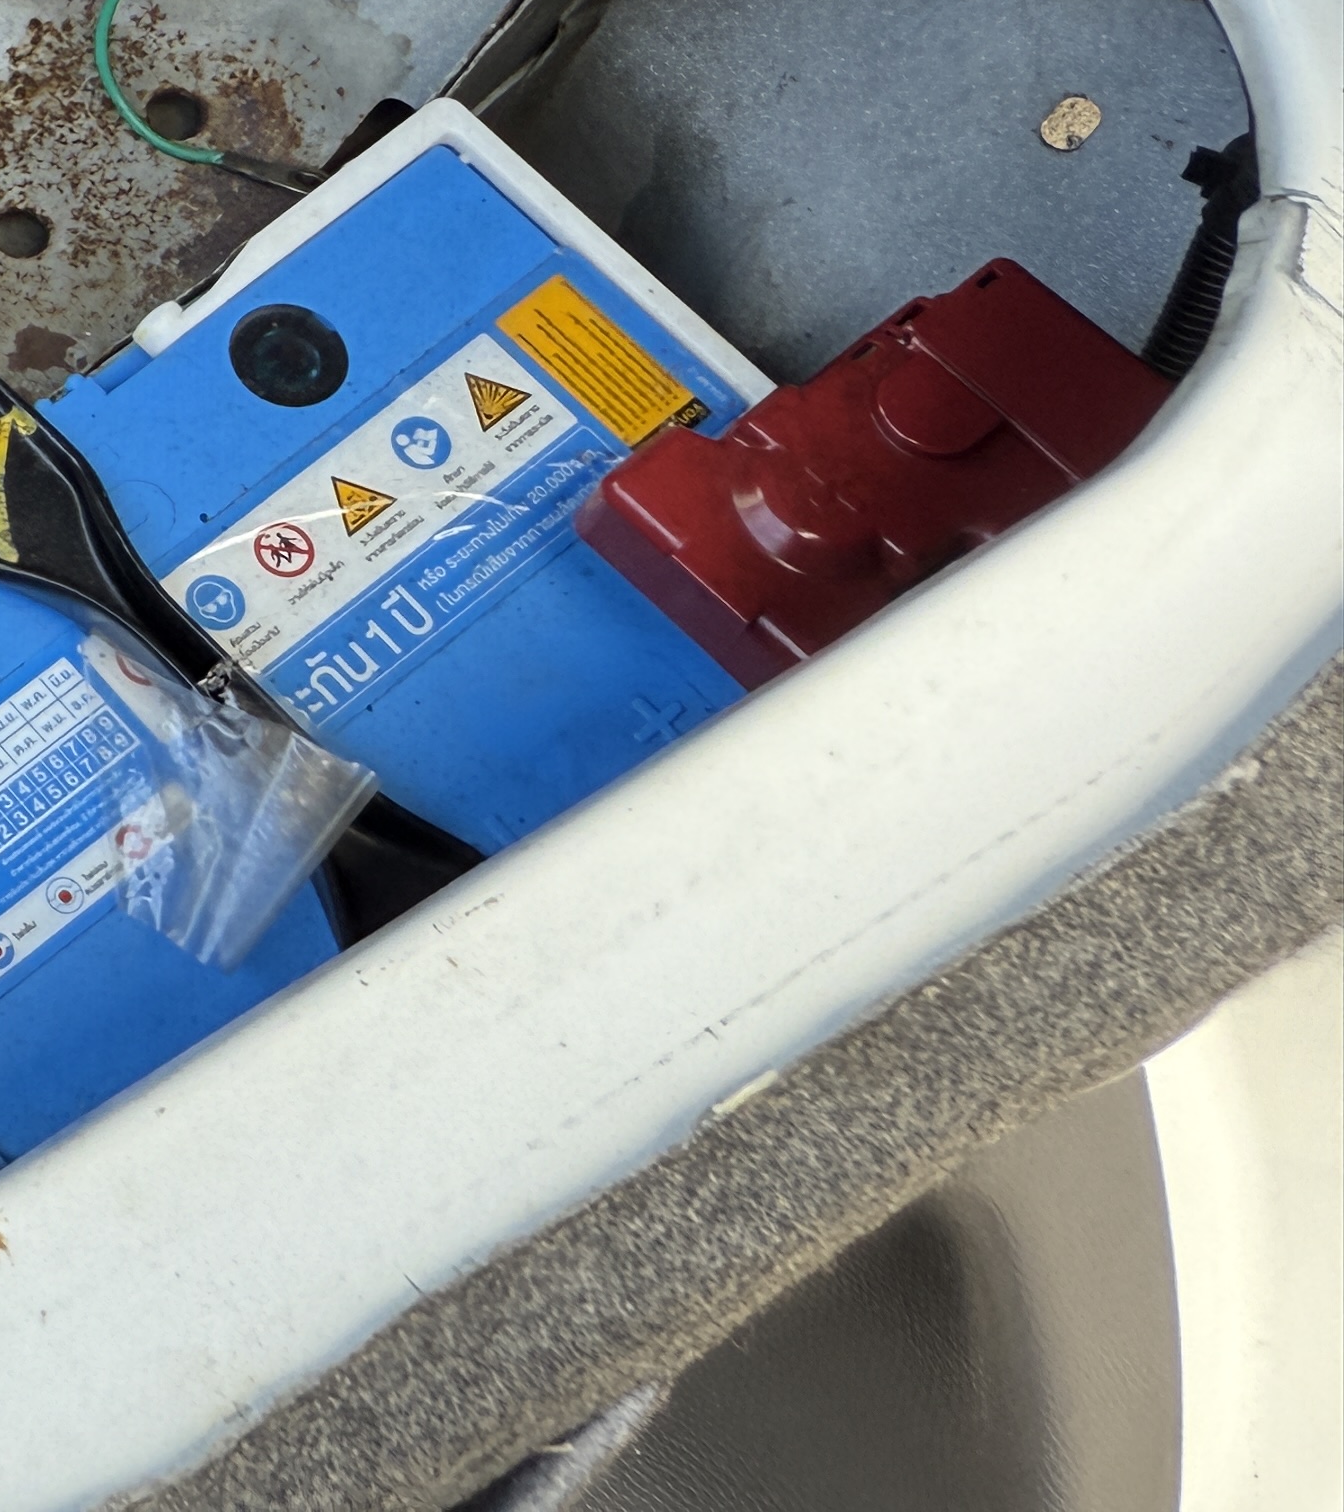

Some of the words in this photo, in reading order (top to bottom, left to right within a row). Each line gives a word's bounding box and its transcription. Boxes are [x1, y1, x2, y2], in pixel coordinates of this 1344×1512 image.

[417, 565, 446, 590] หรือ
[380, 584, 433, 635] ปี
[365, 619, 401, 654] 1
[13, 810, 28, 825] 3
[33, 797, 45, 811] 4
[46, 783, 62, 798] 5
[63, 771, 78, 786] 6
[79, 757, 92, 773] 7
[18, 780, 31, 793] 4
[30, 766, 47, 782] 5
[48, 754, 63, 769] 6
[62, 739, 77, 756] 7
